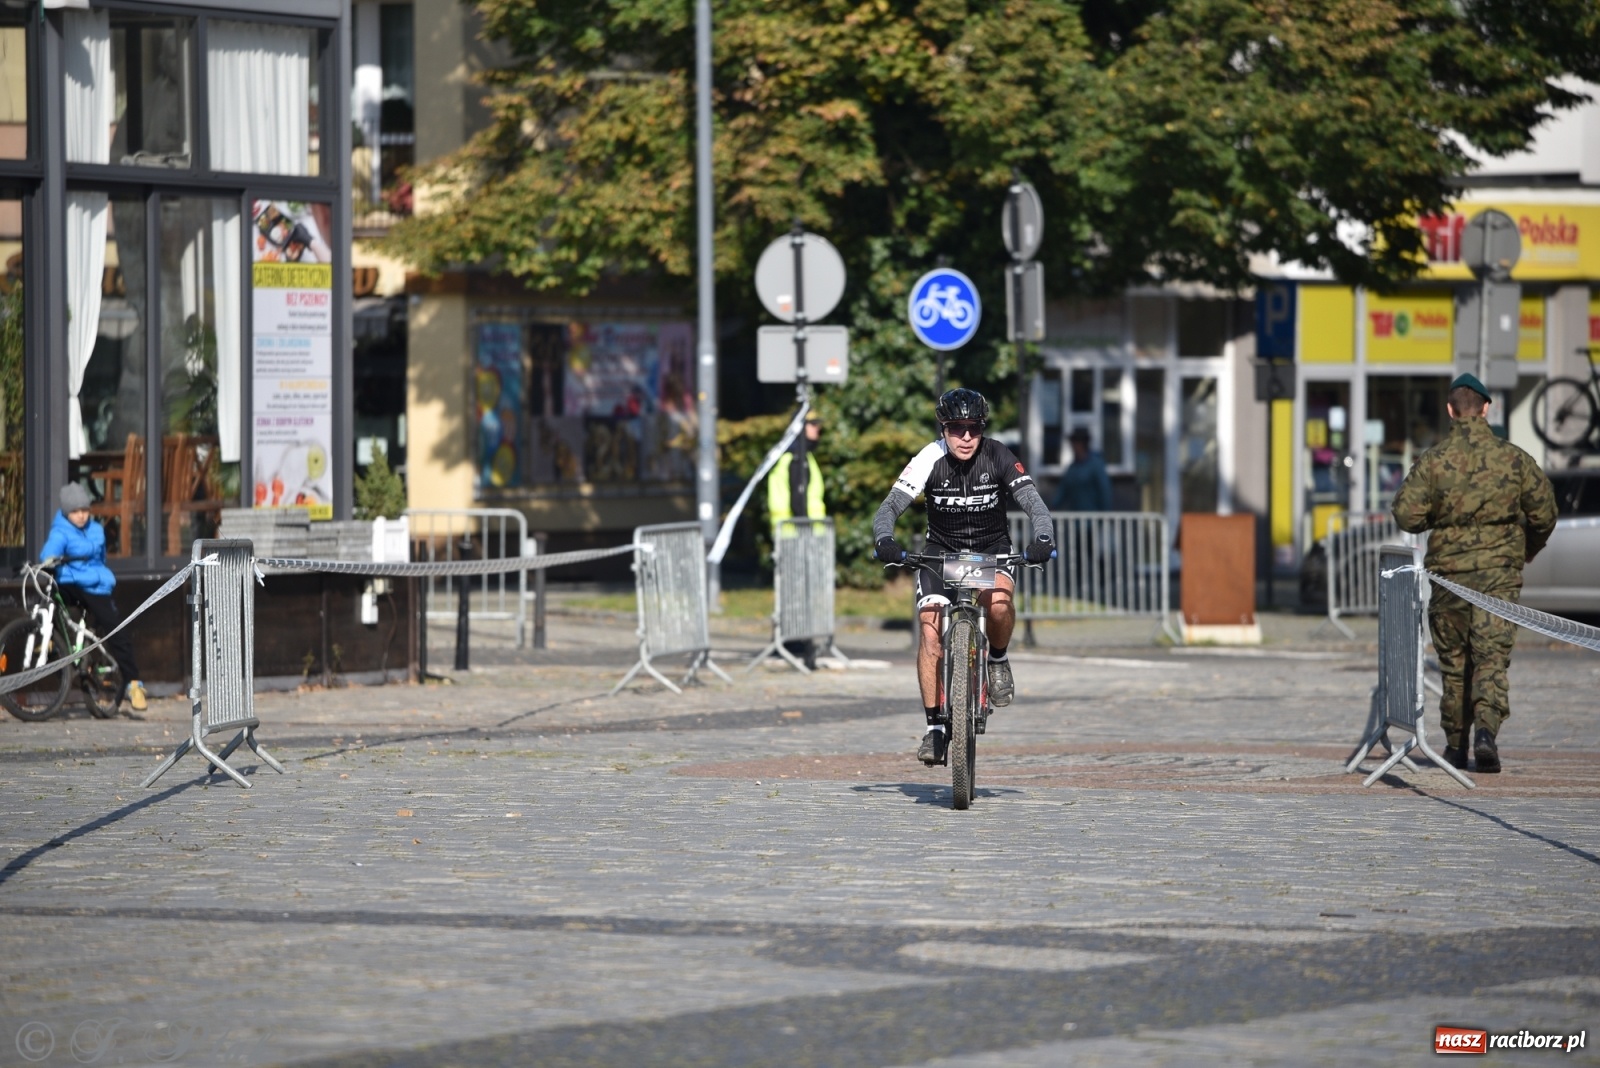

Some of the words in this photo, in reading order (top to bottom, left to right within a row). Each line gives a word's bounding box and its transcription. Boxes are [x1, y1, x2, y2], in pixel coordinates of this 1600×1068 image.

[1519, 214, 1579, 246] Polska
[1265, 285, 1291, 336] P
[931, 490, 999, 506] TREK
[966, 497, 999, 513] RACING
[955, 565, 983, 578] 416
